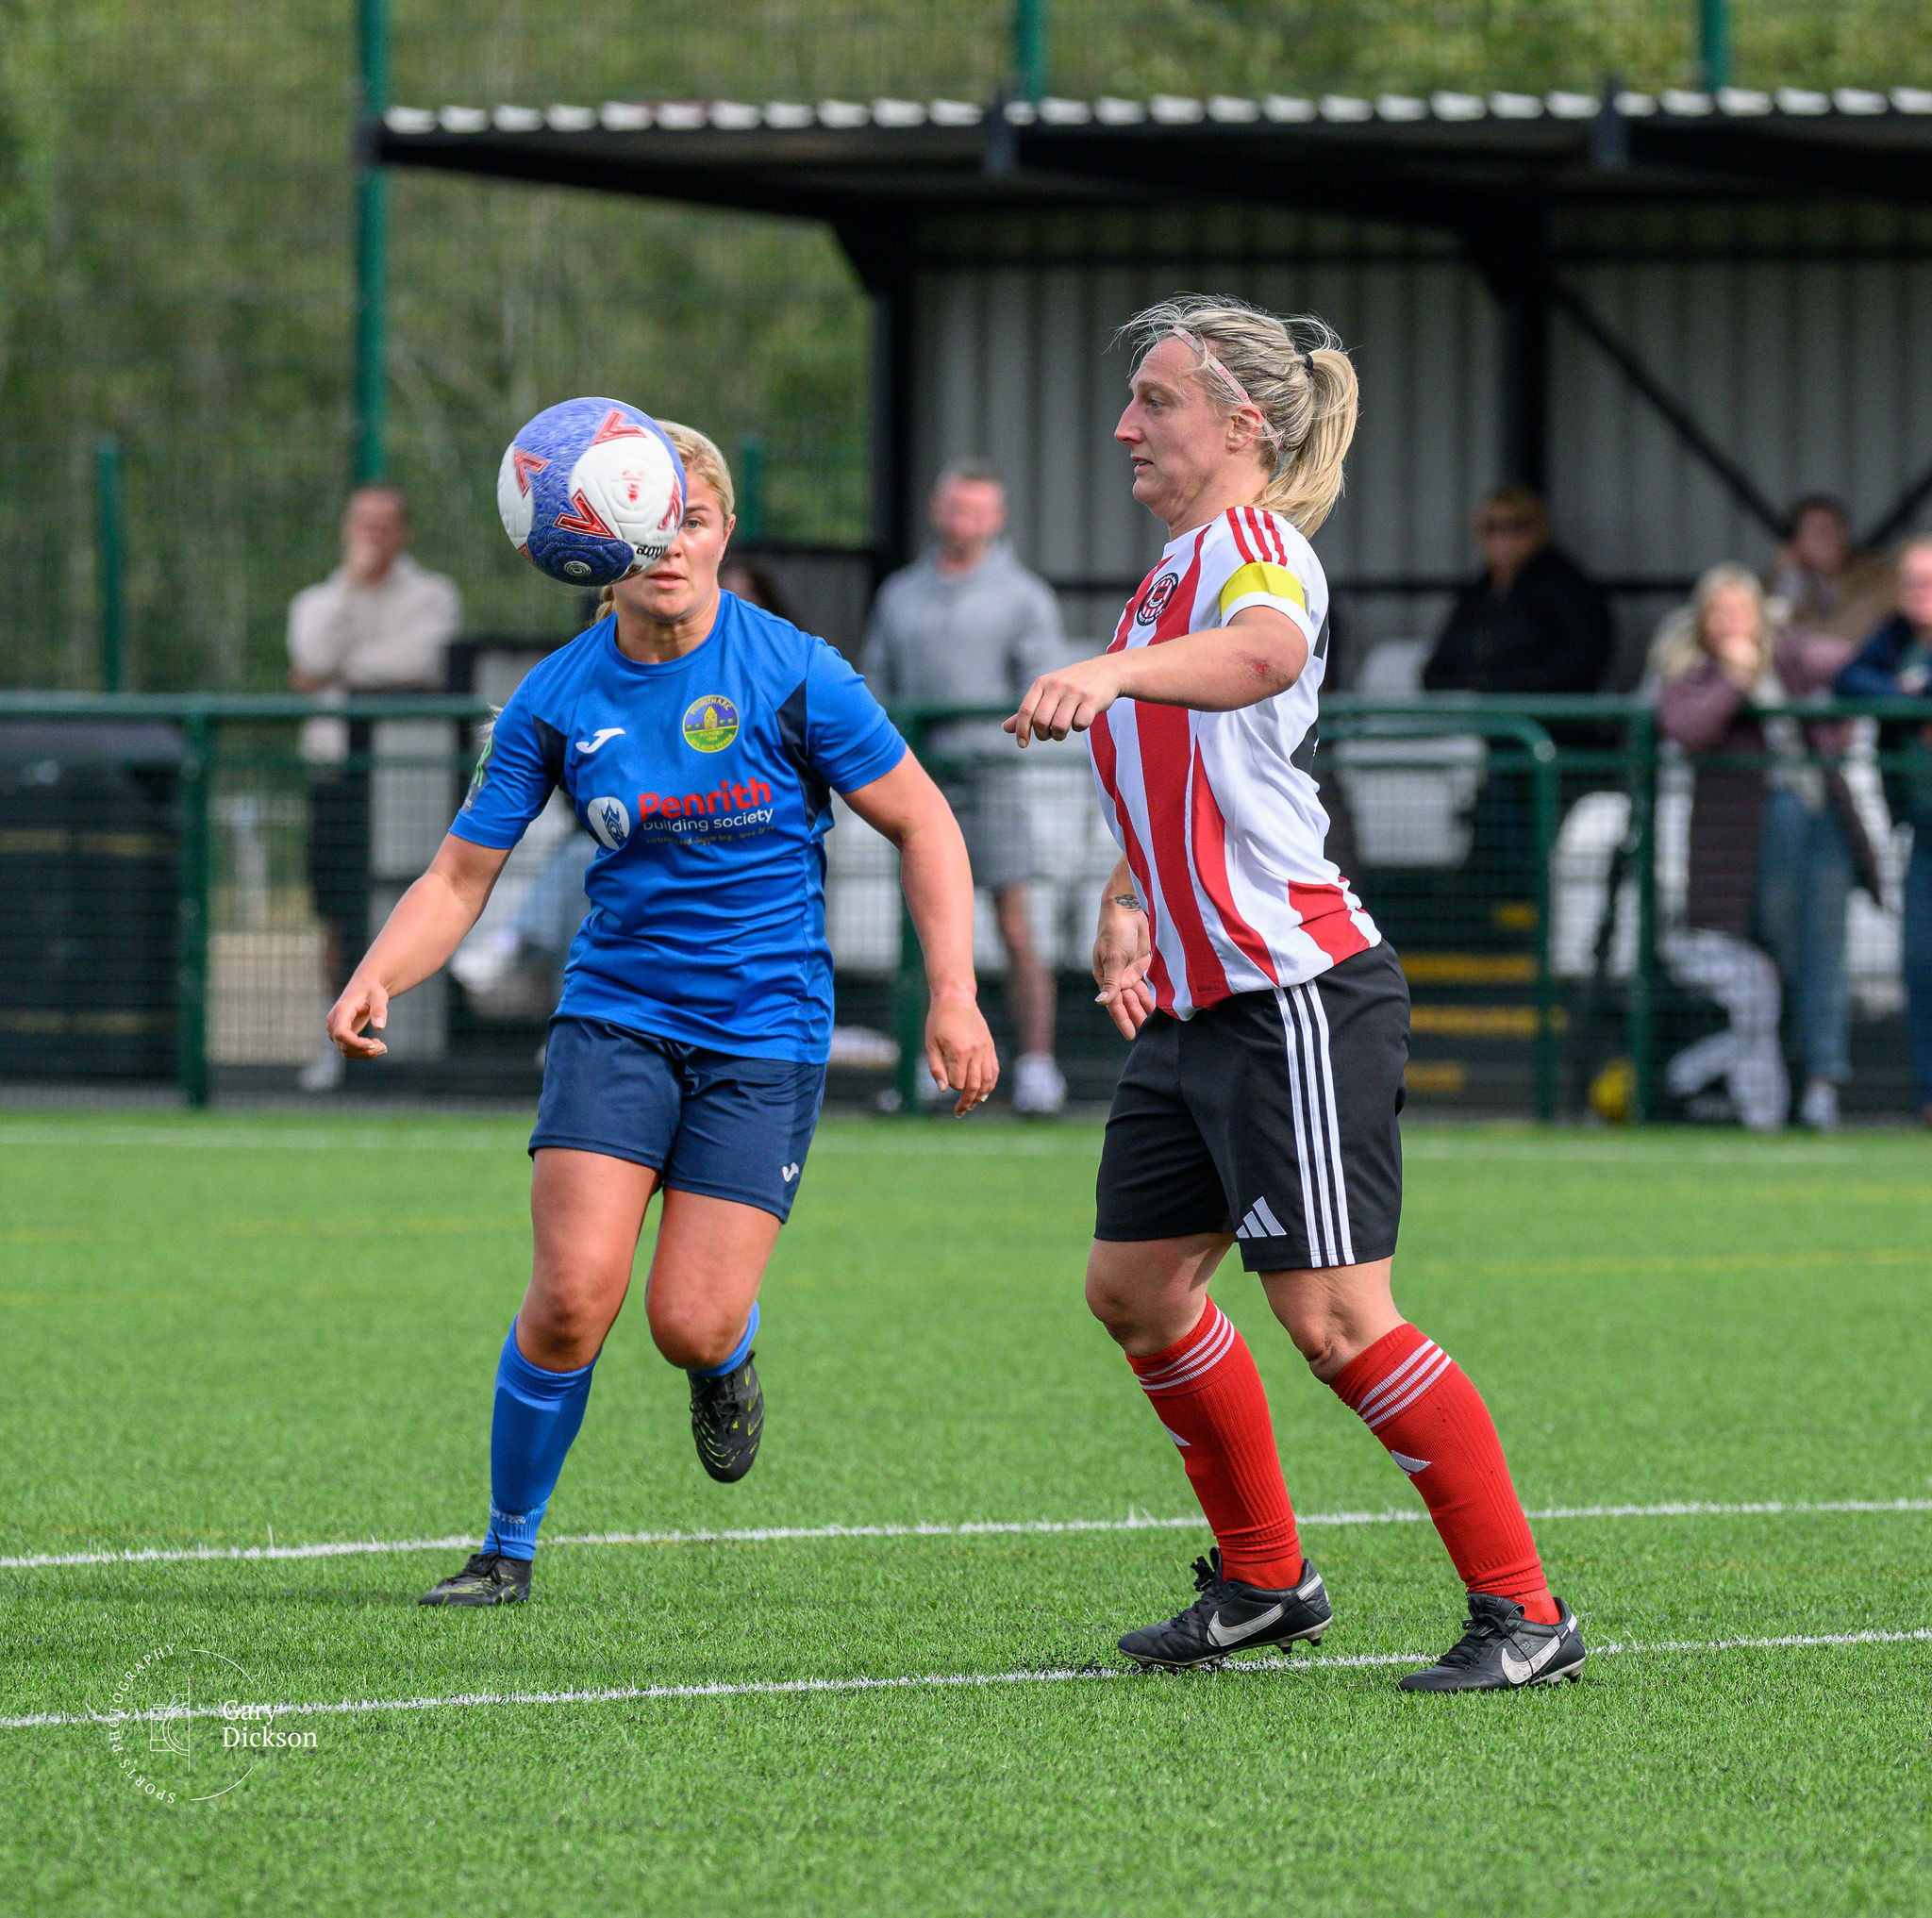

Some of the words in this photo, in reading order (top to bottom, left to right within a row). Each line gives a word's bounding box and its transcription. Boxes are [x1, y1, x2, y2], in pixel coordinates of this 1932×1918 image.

[639, 777, 772, 822] Penrith
[643, 818, 708, 832] building
[713, 808, 774, 829] society
